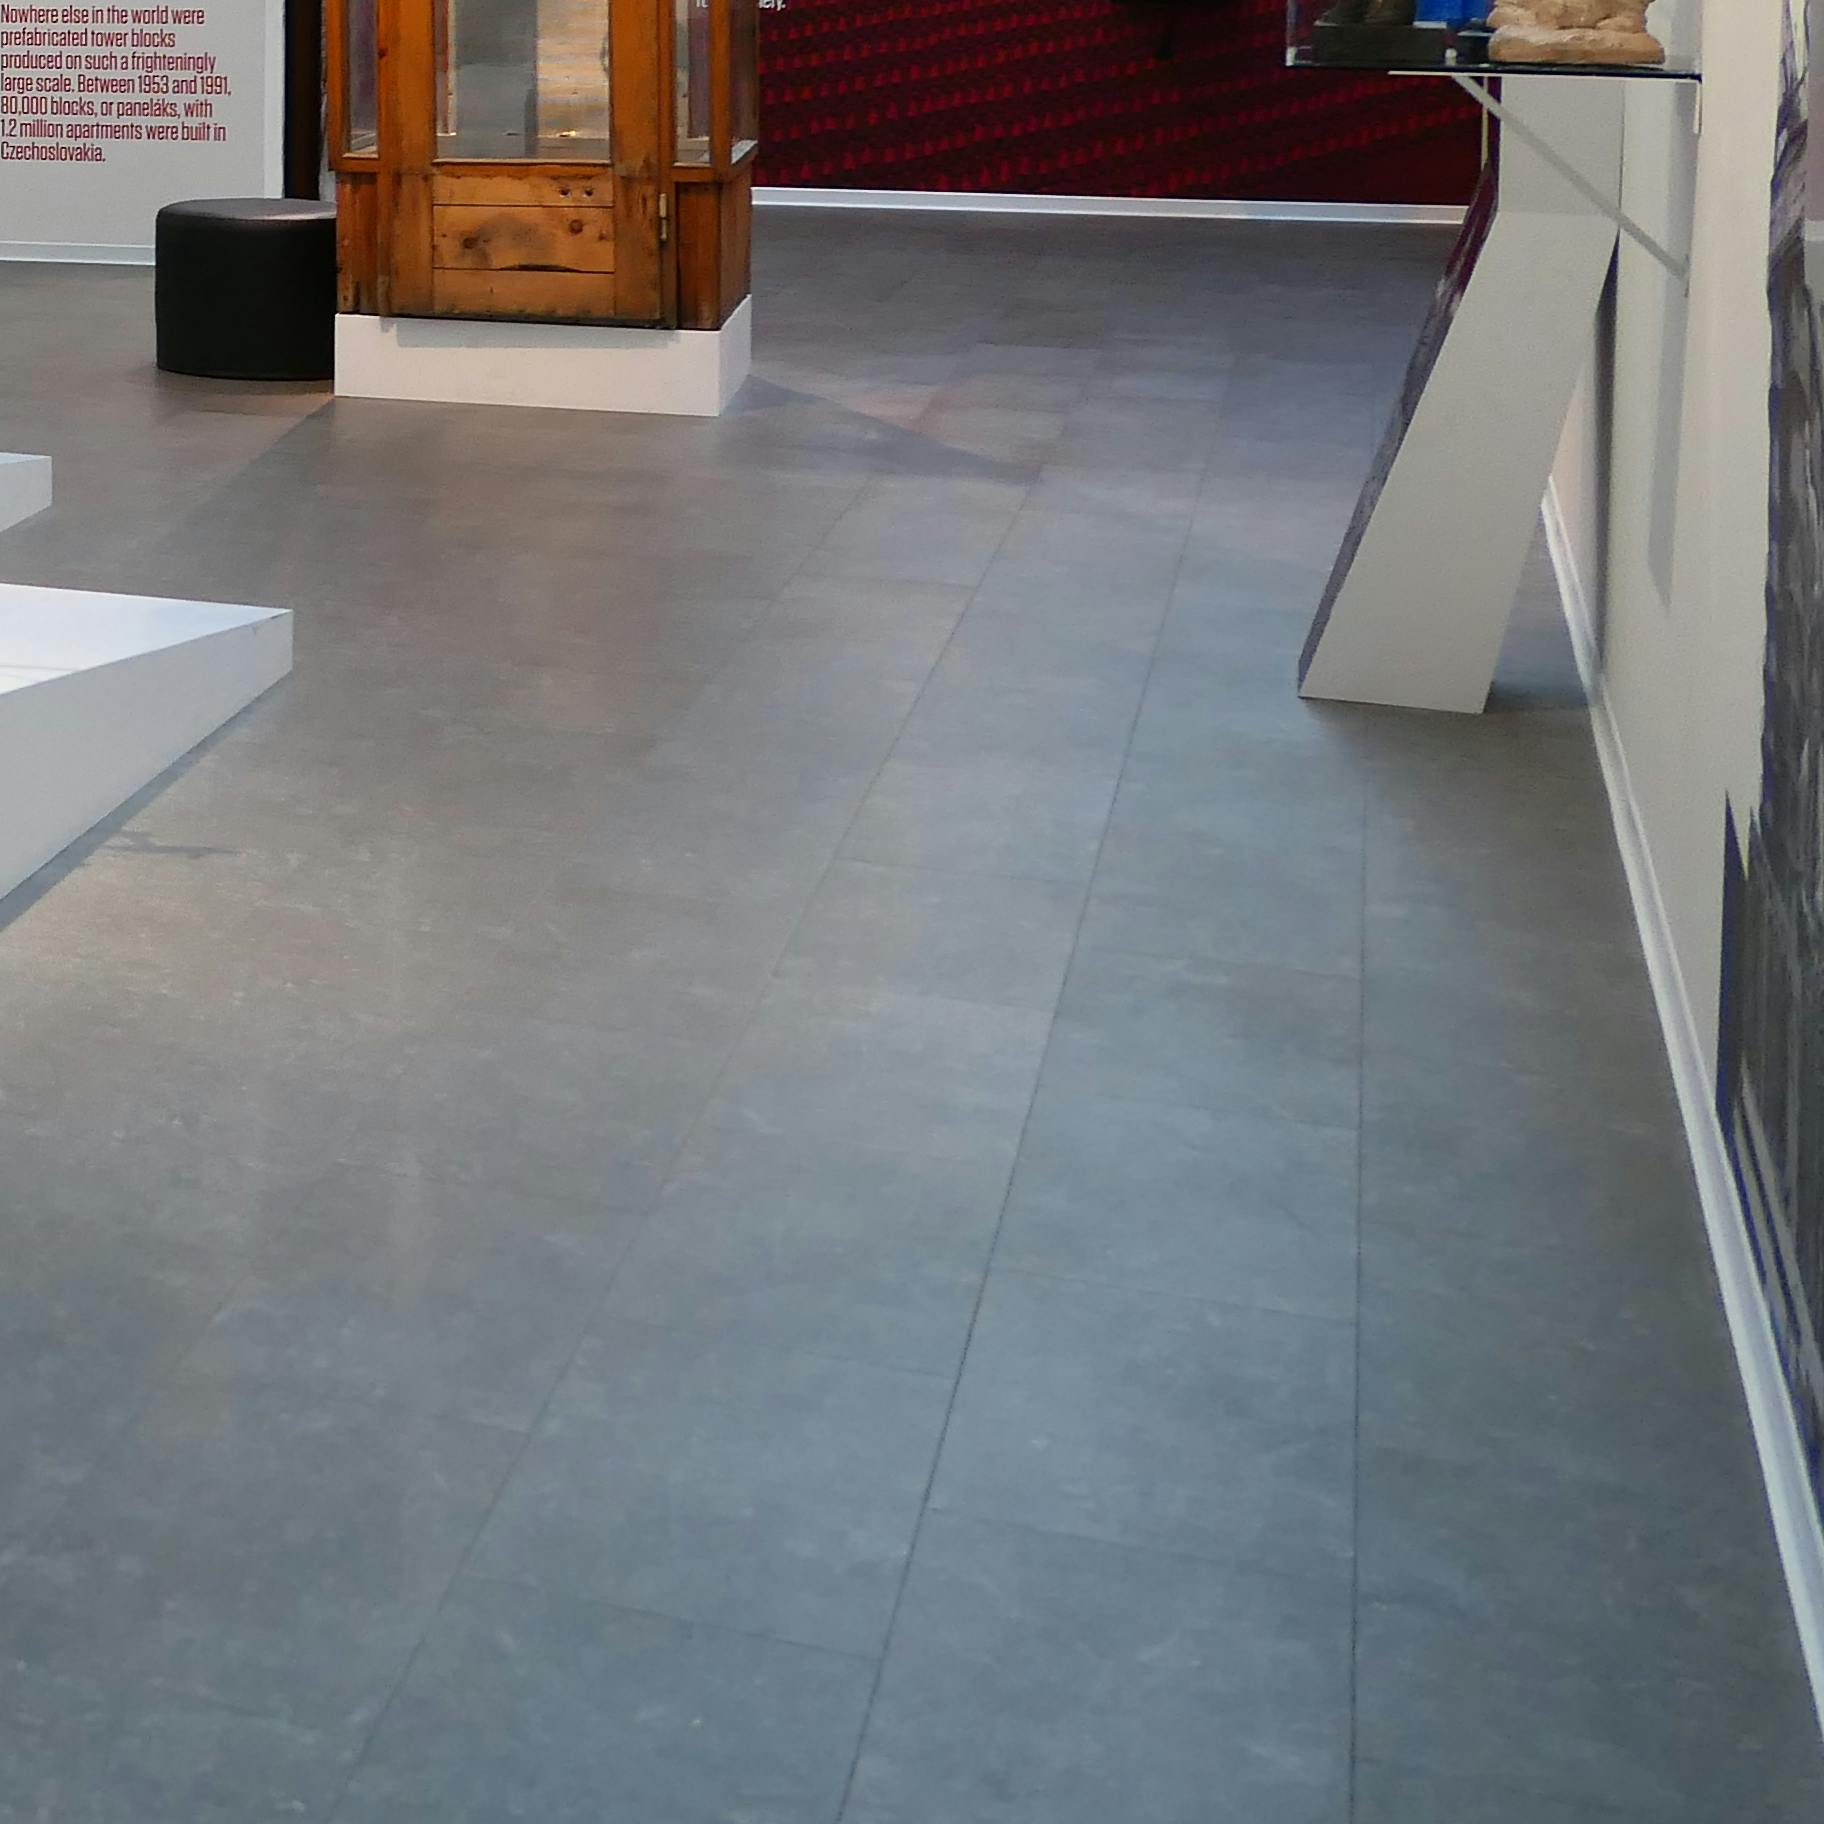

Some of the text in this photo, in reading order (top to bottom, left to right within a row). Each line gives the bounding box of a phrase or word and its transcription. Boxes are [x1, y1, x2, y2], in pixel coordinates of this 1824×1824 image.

[1, 4, 204, 24] Nowhere else in the world were
[1, 28, 175, 48] prefabricated tower blocks
[1, 51, 216, 74] produced on such a frighteningly
[1, 74, 231, 96] large scale. Between 1953 and 1991,
[1, 97, 213, 119] 80,000 blocks, or paneláks, with
[1, 119, 226, 142] 1.2 million apartments were built in
[1, 142, 105, 162] Czechoslovakia.
